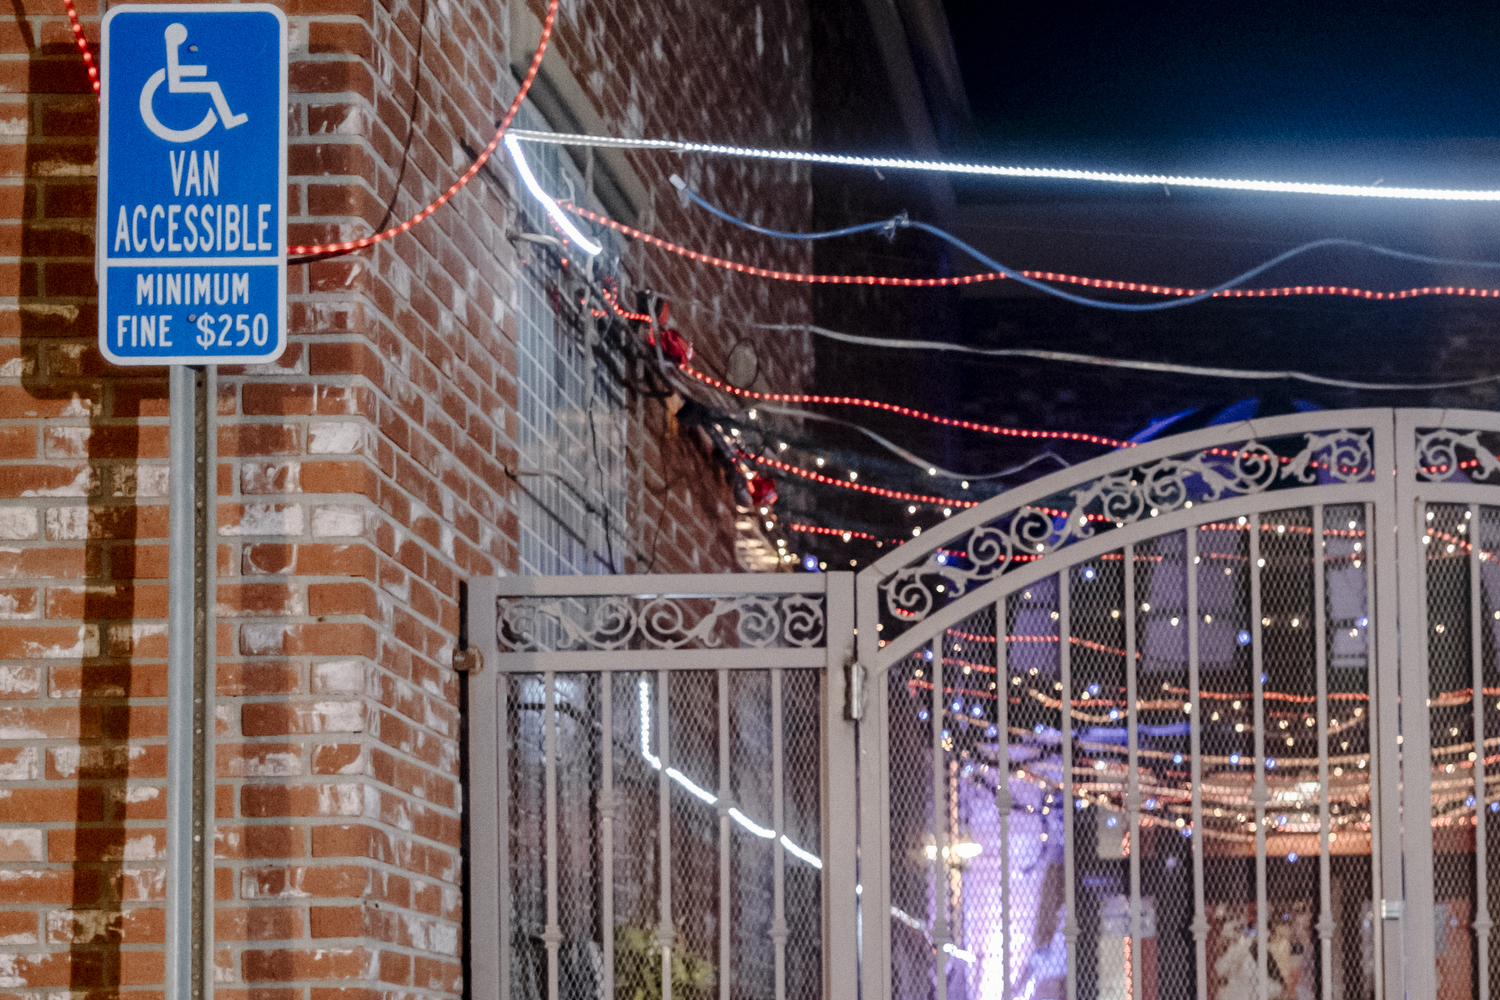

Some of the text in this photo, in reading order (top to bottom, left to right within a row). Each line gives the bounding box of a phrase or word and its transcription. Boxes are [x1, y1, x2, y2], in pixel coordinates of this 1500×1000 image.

[169, 150, 219, 197] VAN
[114, 204, 272, 252] ACCESSIBLE
[136, 272, 249, 306] MINIMUM
[117, 312, 269, 350] FINE $250
